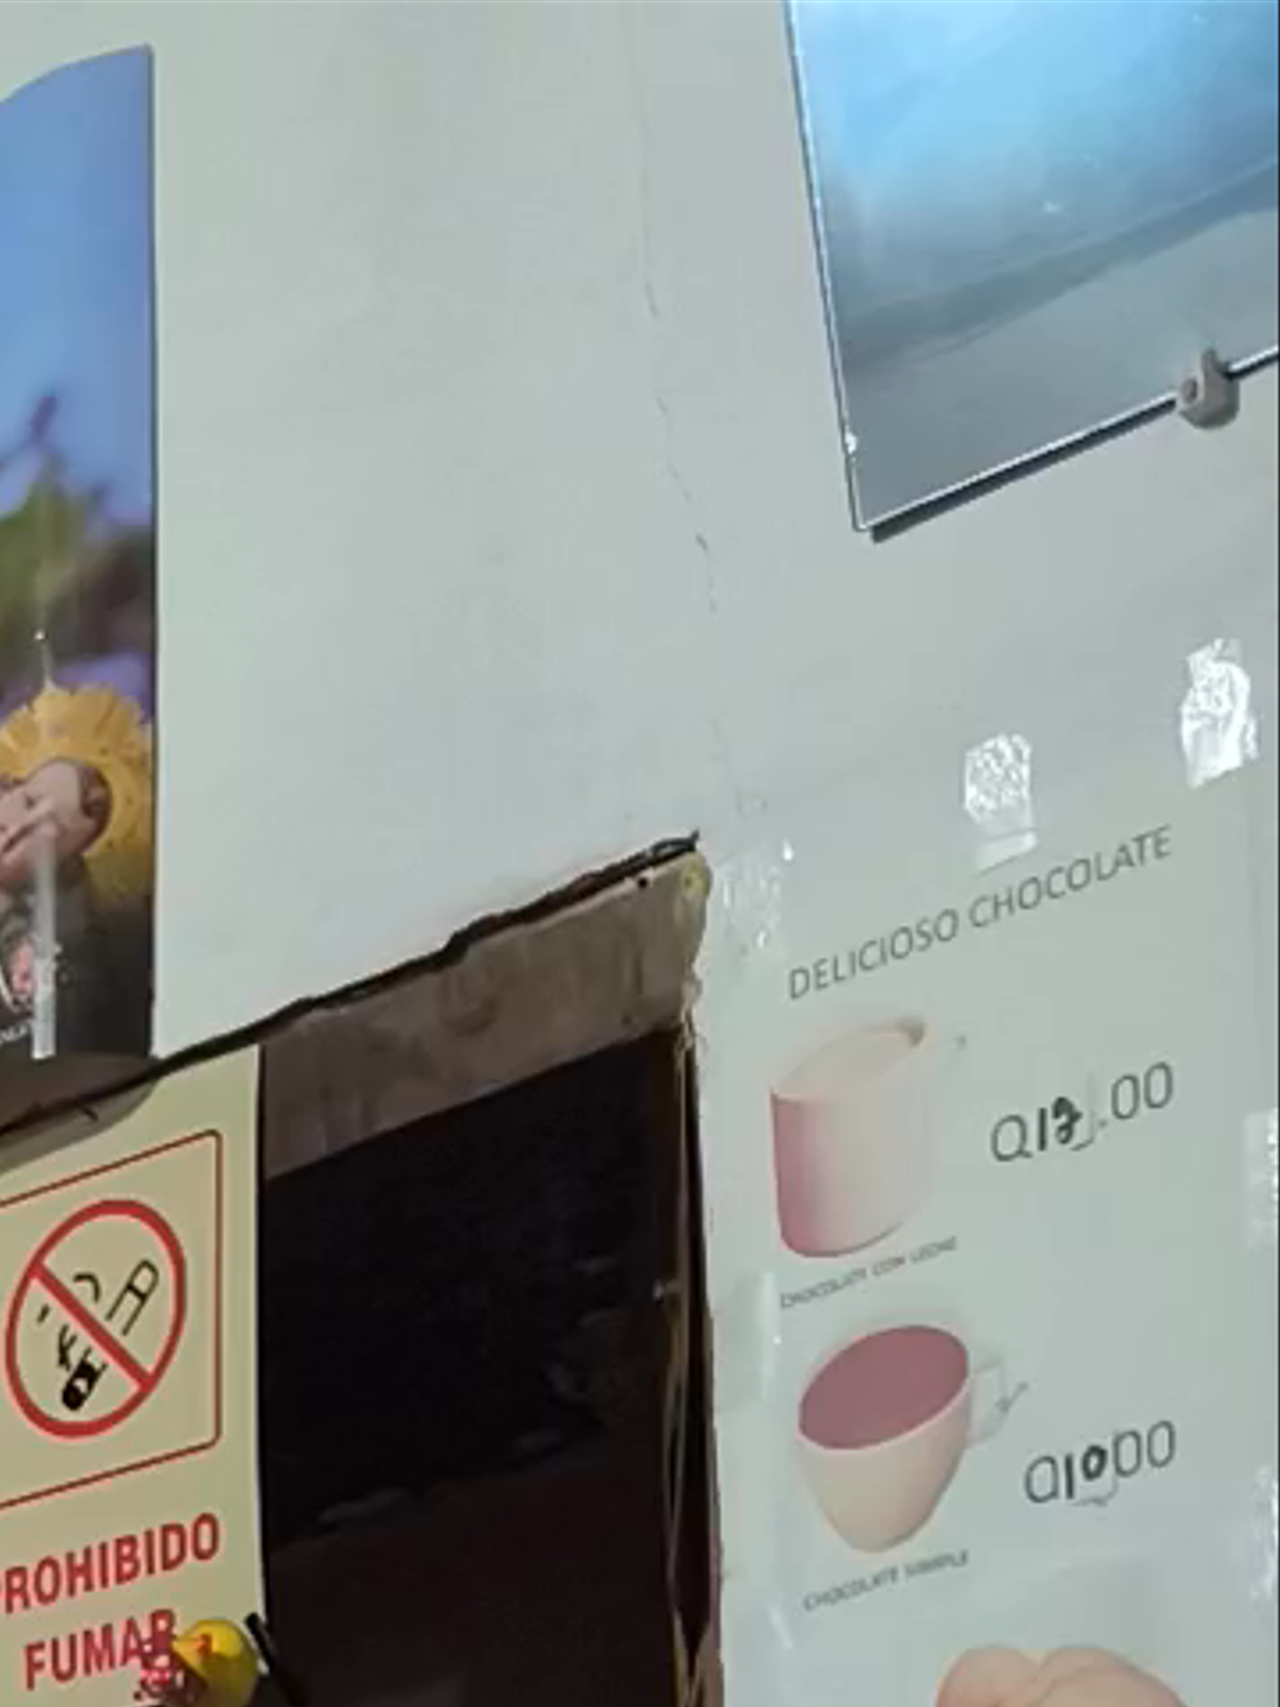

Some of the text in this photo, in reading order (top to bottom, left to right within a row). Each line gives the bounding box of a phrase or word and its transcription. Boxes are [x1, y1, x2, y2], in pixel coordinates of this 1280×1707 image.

[788, 823, 1172, 1000] DELICIOSO CHOCOLATE
[24, 1608, 176, 1692] FUMAR
